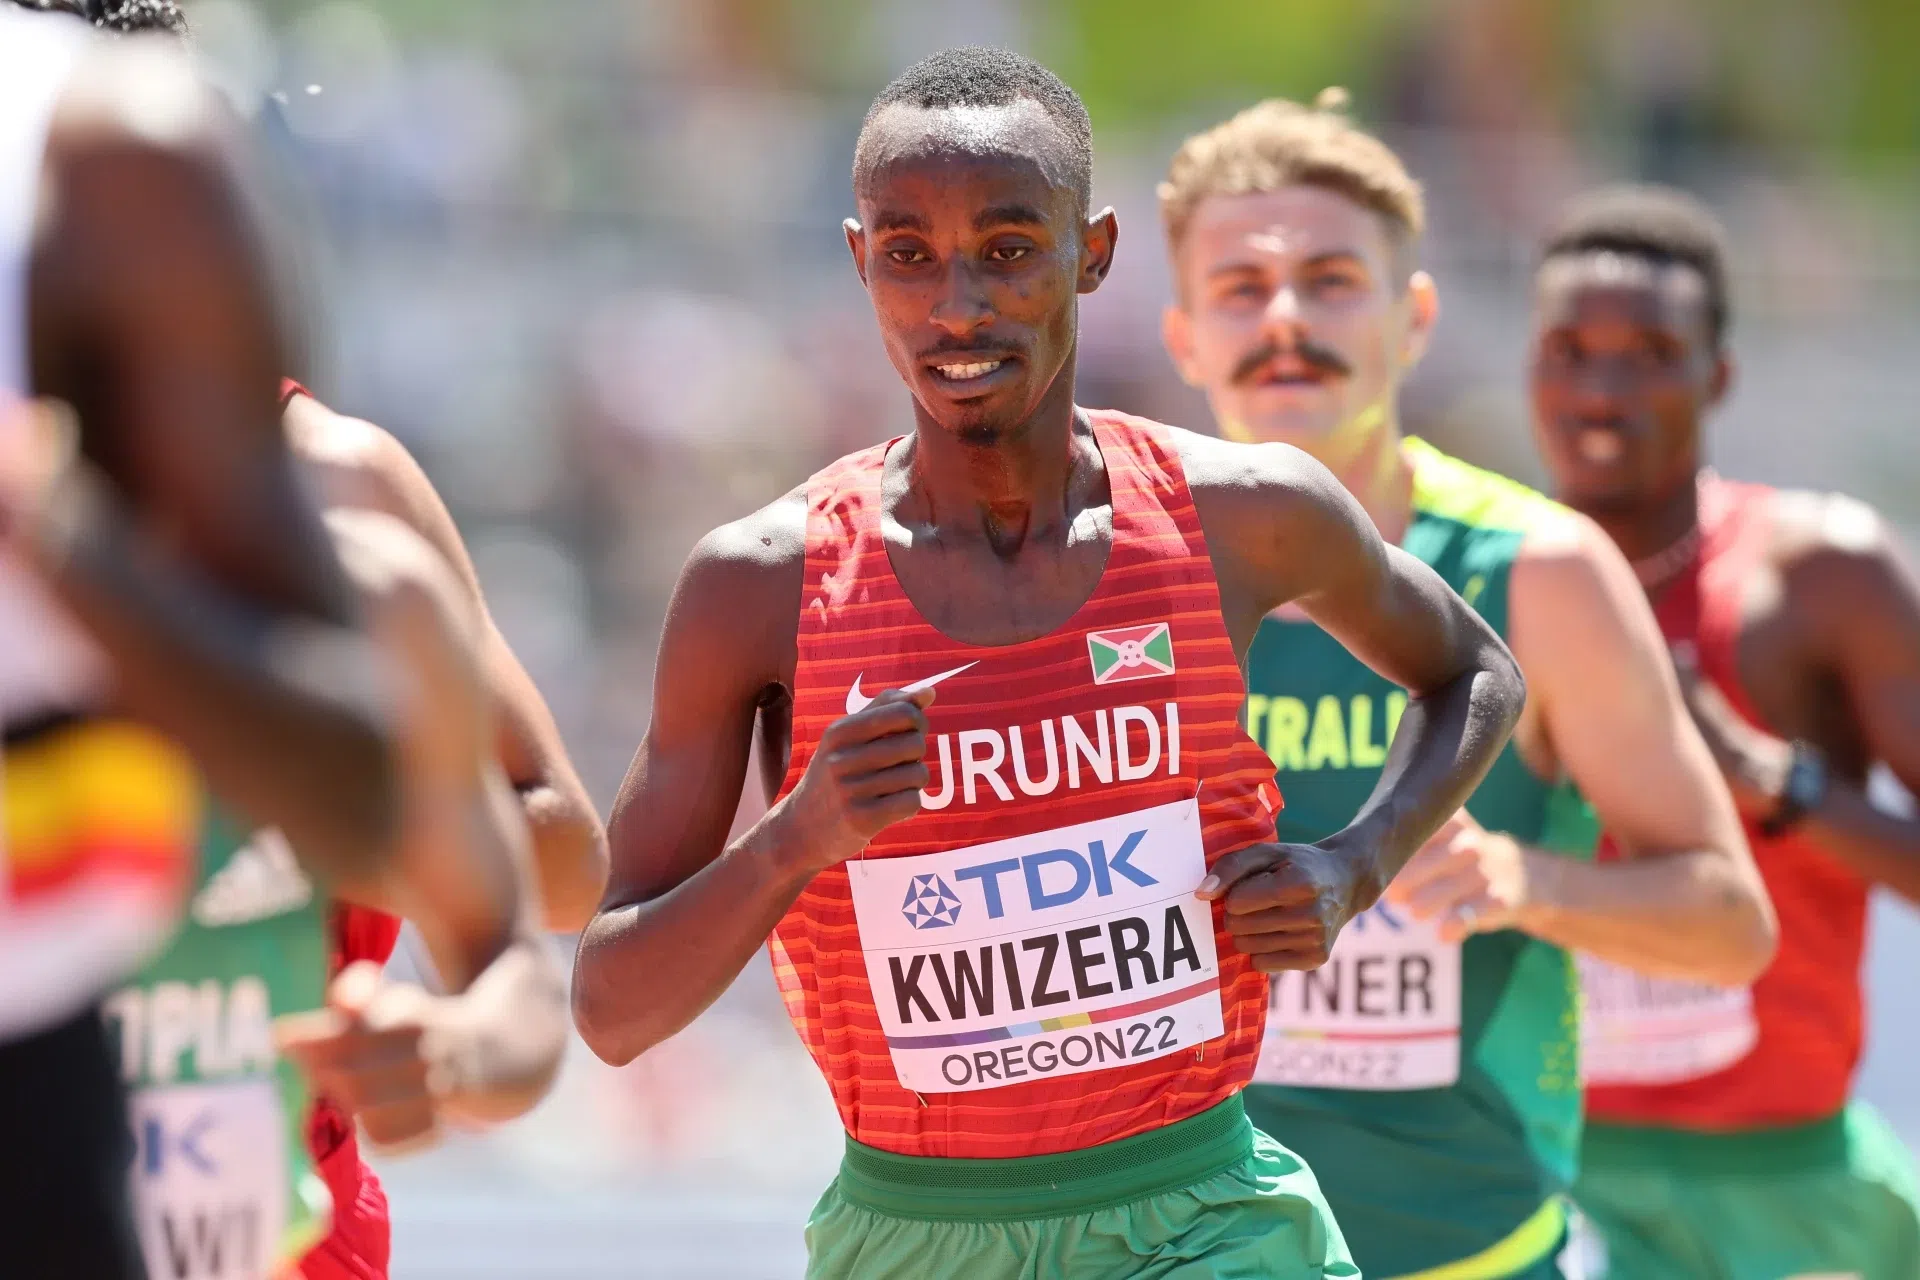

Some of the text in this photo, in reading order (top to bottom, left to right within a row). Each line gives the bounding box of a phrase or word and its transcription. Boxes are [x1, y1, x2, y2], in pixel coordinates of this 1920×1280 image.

[918, 702, 1181, 810] URUNDI
[1247, 690, 1409, 772] TRALI
[954, 829, 1160, 920] TDK
[888, 904, 1202, 1024] KWIZERA
[1268, 954, 1433, 1016] YNER
[941, 1015, 1179, 1086] OREGON22
